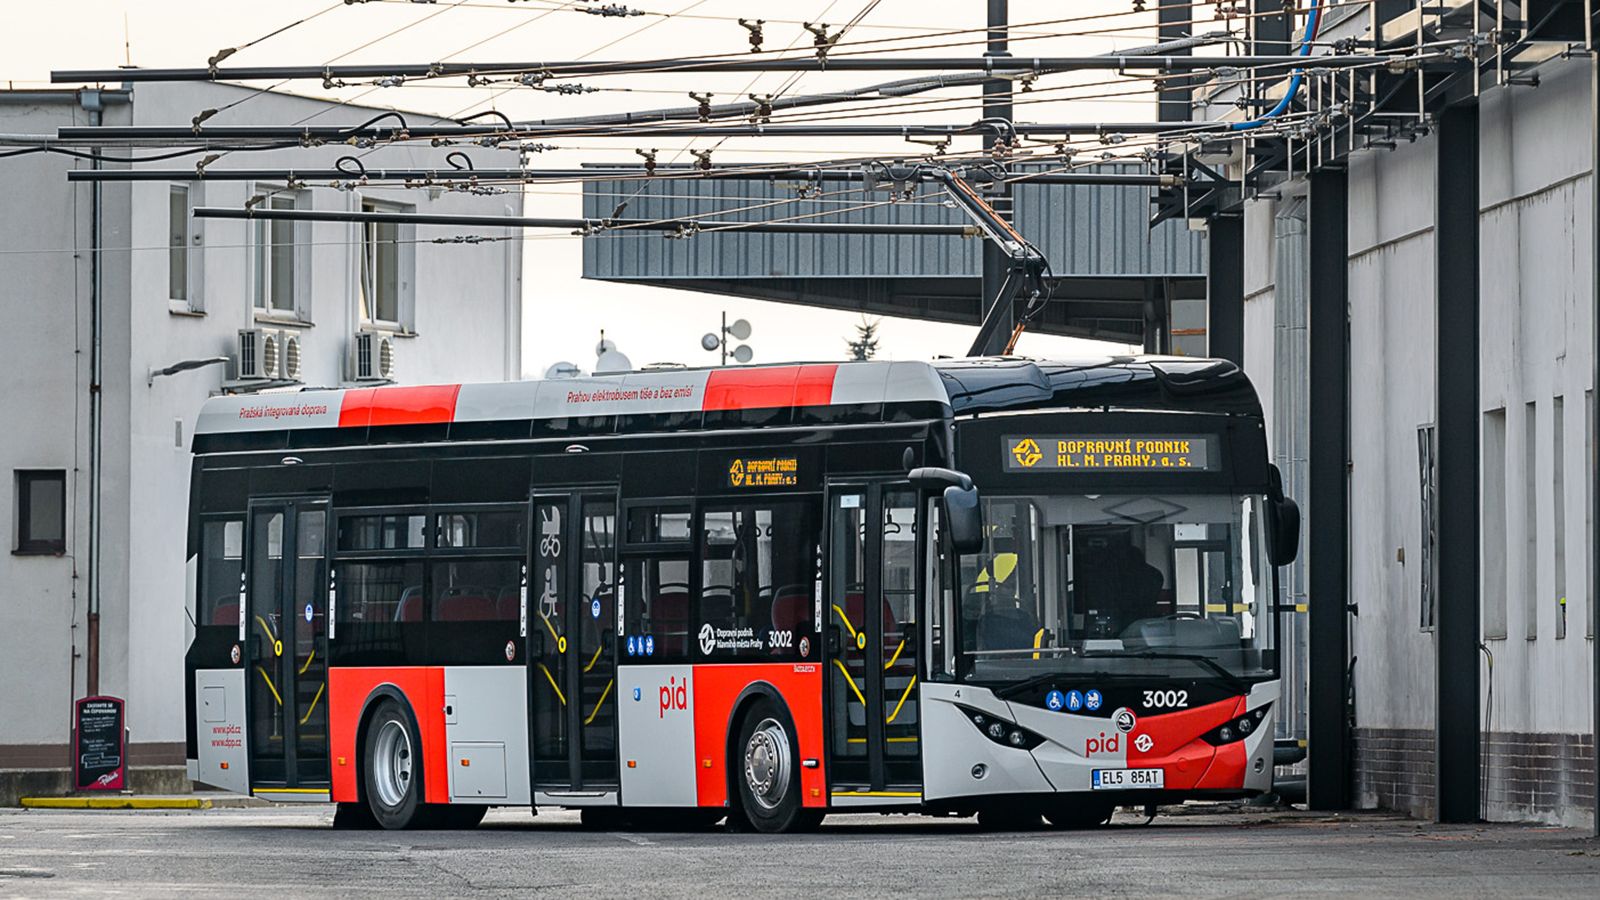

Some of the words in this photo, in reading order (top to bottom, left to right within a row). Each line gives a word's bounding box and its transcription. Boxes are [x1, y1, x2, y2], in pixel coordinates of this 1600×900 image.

[566, 390, 590, 403] Prahou
[592, 388, 638, 401] elektrobusem
[640, 387, 652, 400] tiše
[653, 390, 659, 399] a
[660, 386, 672, 399] bez
[674, 384, 694, 398] emisí
[239, 406, 263, 419] Pražská
[264, 403, 300, 419] integrovaná
[301, 403, 327, 418] doprava
[1057, 439, 1131, 454] DOPRAVNÍ
[1136, 441, 1190, 454] PODNIK
[1057, 454, 1080, 467] HL.
[1084, 454, 1100, 467] M.
[1104, 454, 1157, 467] PRAHY,
[716, 628, 737, 639] Dopravní
[737, 627, 754, 639] podnik
[768, 630, 793, 648] 3002
[750, 638, 763, 650] Prahy
[659, 675, 687, 719] pid
[954, 689, 961, 698] 4
[1142, 690, 1188, 708] 3002
[1085, 732, 1119, 758] pid
[1102, 771, 1123, 784] EL5
[1131, 770, 1158, 784] 85AT
